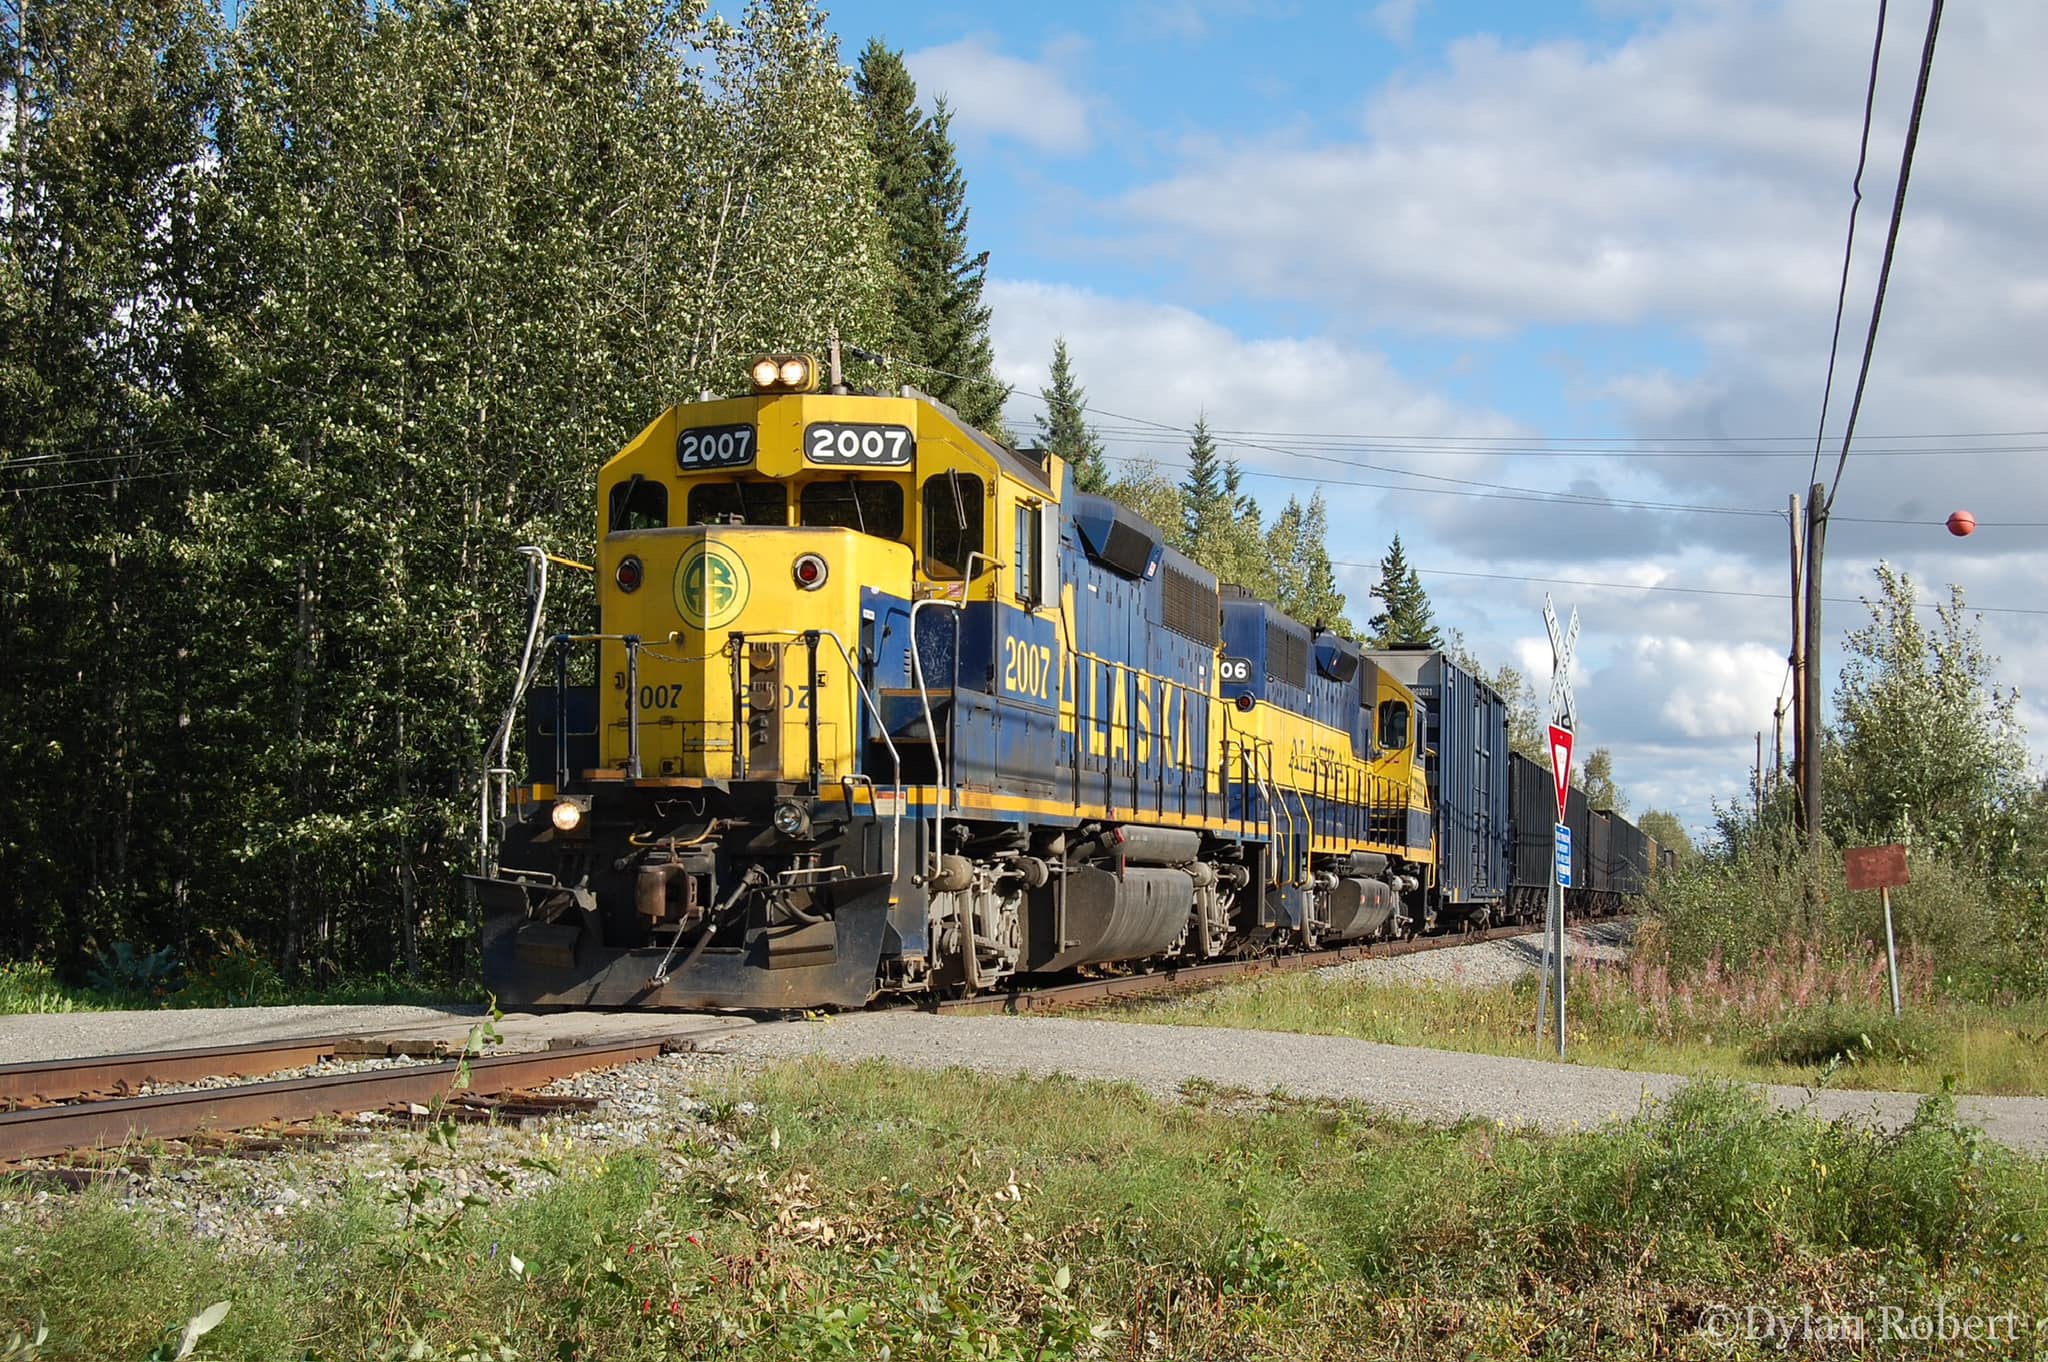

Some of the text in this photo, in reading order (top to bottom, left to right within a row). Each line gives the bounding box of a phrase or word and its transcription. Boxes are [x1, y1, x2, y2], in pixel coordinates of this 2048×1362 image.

[682, 430, 751, 463] 2007
[812, 429, 907, 458] 2007
[1005, 635, 1051, 700] 2007
[1059, 584, 1192, 773] ALASKA
